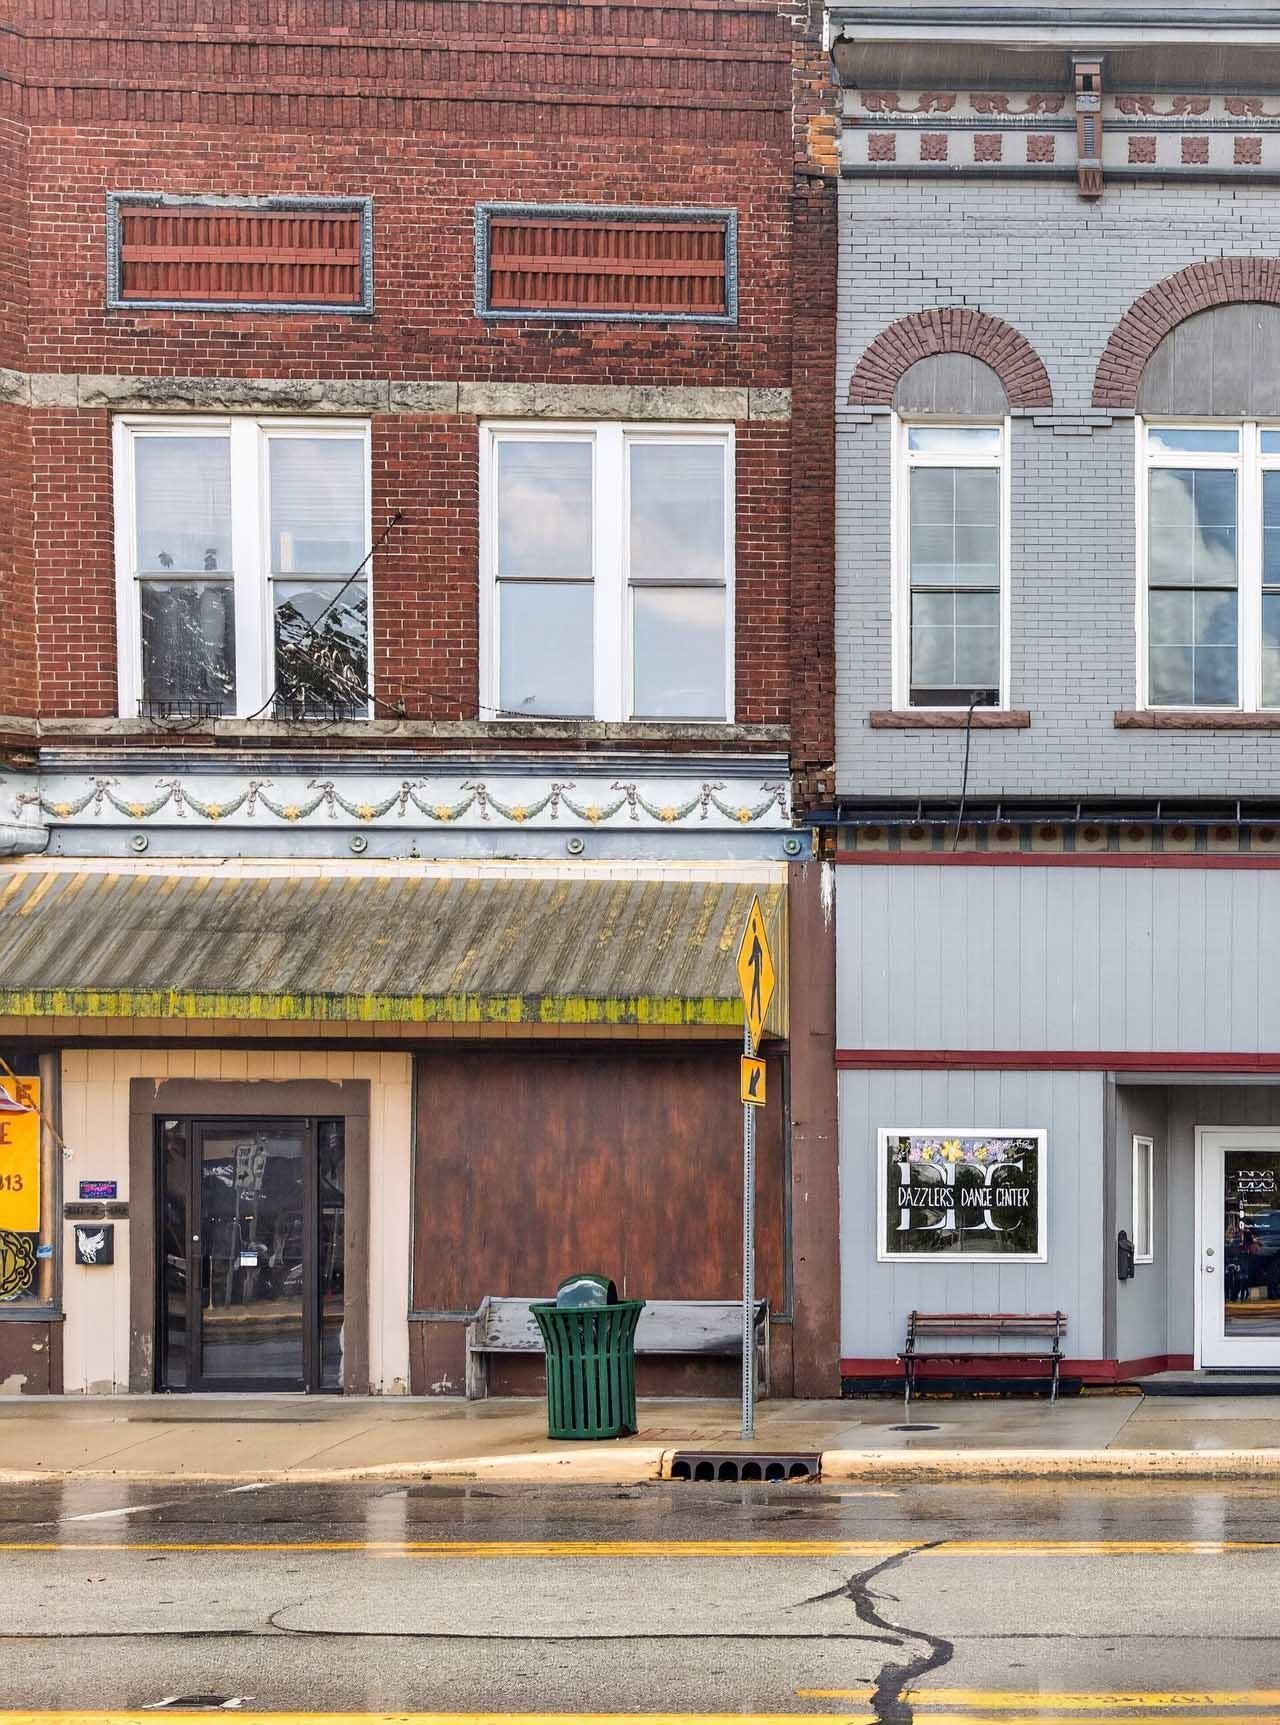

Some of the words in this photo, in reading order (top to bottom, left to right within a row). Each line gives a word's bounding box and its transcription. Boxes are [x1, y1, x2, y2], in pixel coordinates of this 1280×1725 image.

[898, 1187, 954, 1207] DAZZLERS
[961, 1187, 993, 1207] DANCE
[995, 1187, 1030, 1207] CENTER
